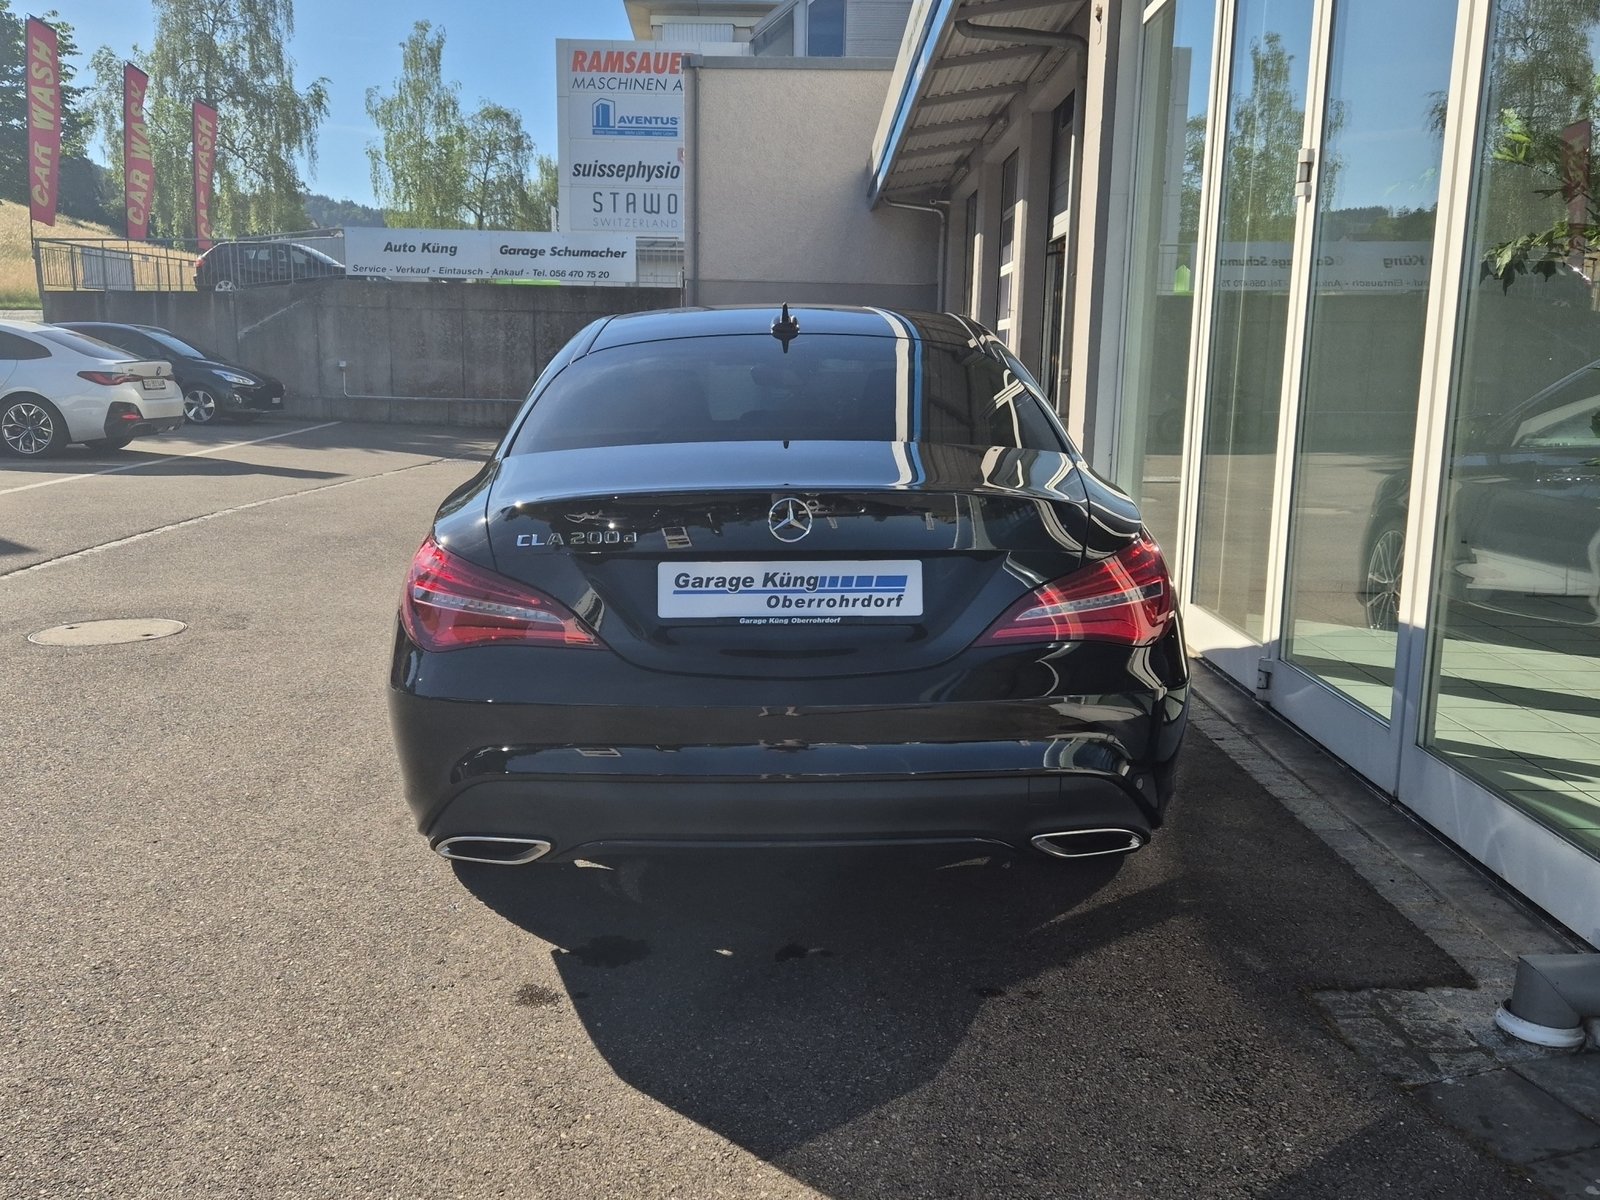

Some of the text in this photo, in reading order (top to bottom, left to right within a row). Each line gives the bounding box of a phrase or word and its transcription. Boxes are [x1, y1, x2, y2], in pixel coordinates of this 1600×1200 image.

[572, 51, 684, 74] RAMSAUE
[572, 77, 667, 91] MASCHINEN
[30, 36, 55, 208] CAR WASH
[618, 116, 677, 125] AVENTUS
[573, 160, 680, 182] suissephysio
[127, 170, 150, 226] CAR
[593, 192, 677, 214] STAWO
[593, 217, 678, 228] SWITZERLAND
[383, 242, 458, 256] Auto Küng
[499, 245, 627, 258] Garage Schumacher
[352, 264, 386, 273] Service
[396, 265, 430, 274] Verkauf
[439, 266, 483, 276] Eintausch
[492, 268, 524, 276] Ankauf
[533, 269, 547, 277] Tel.
[568, 270, 584, 278] 470
[598, 271, 609, 279] 20
[516, 532, 564, 547] CLA
[674, 572, 819, 593] Garage Küng
[766, 594, 903, 609] Oberrohrdorf
